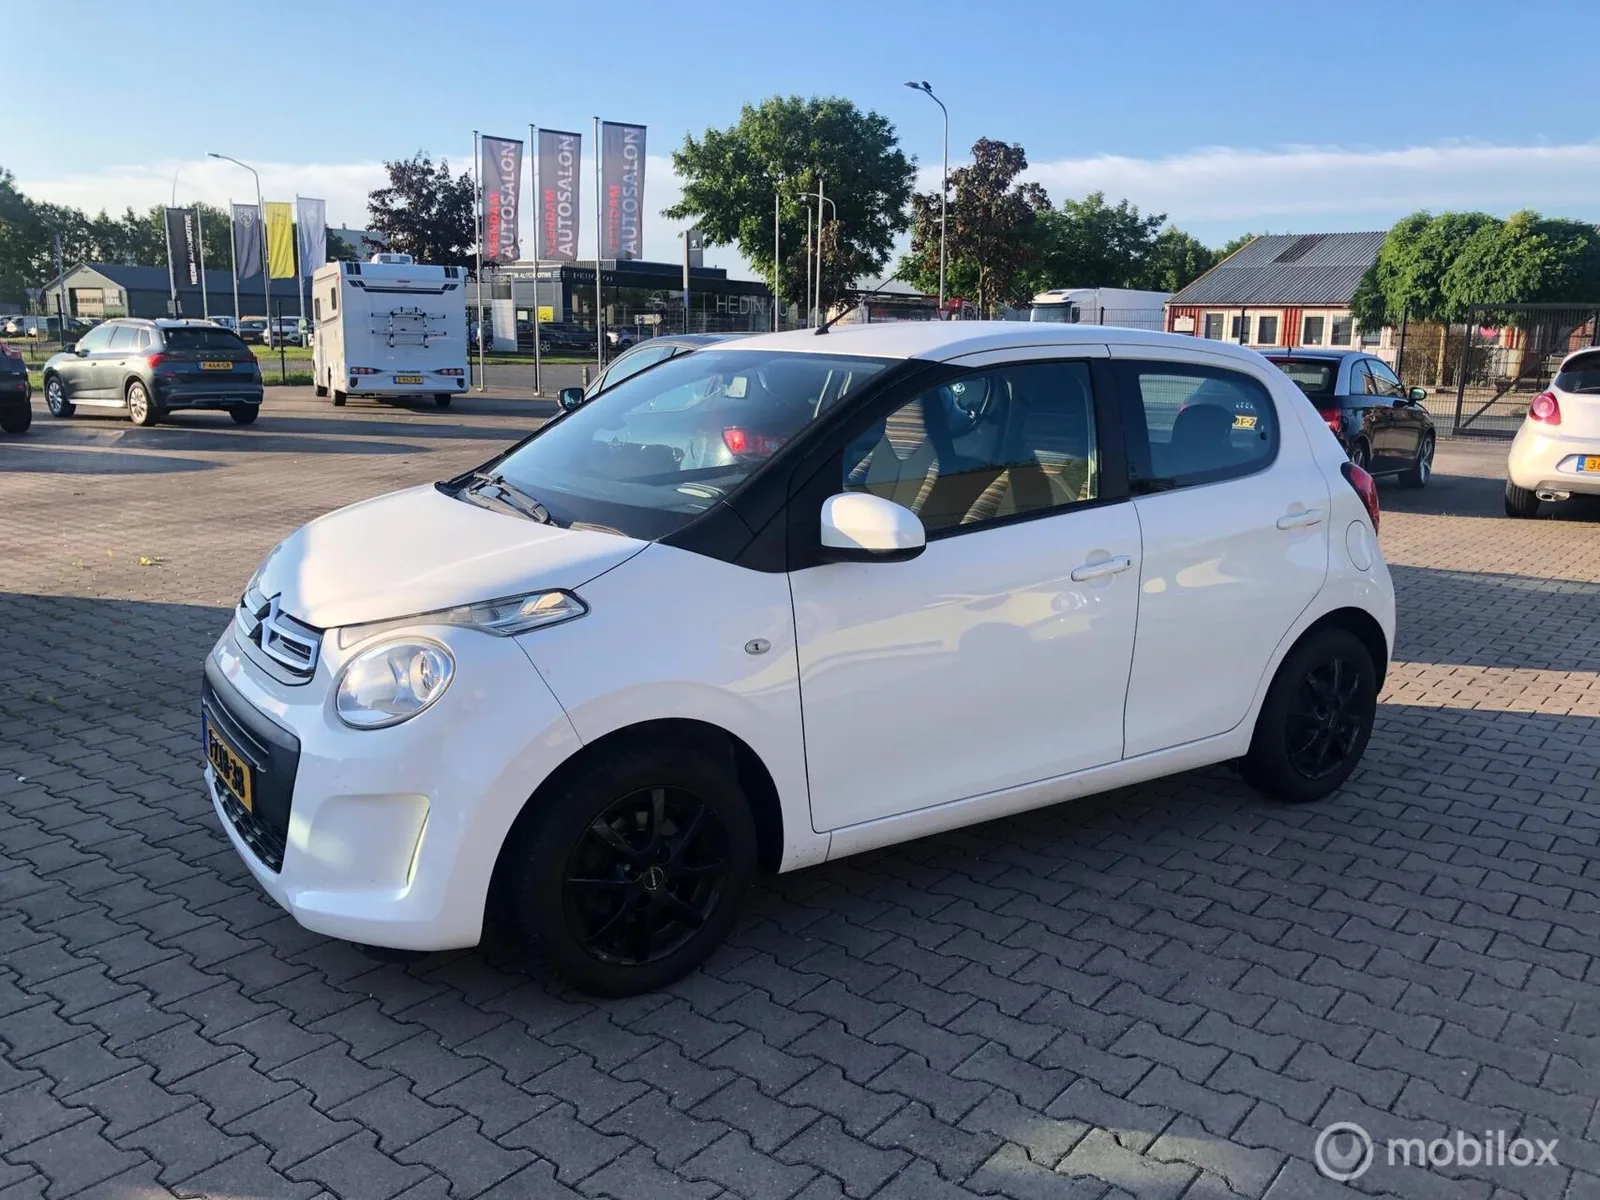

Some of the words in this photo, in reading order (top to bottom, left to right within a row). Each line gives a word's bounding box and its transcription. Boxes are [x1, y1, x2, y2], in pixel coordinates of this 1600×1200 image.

[488, 190, 500, 258] VEENDAM
[501, 142, 516, 258] AUTOSALON
[545, 188, 556, 257] VEENDAM
[557, 135, 574, 256] AUTOSALON
[622, 127, 640, 255] AUTOSALON
[184, 213, 195, 262] AUTOMOTIVE
[190, 262, 198, 285] HEDIN
[716, 293, 764, 316] HEDIN
